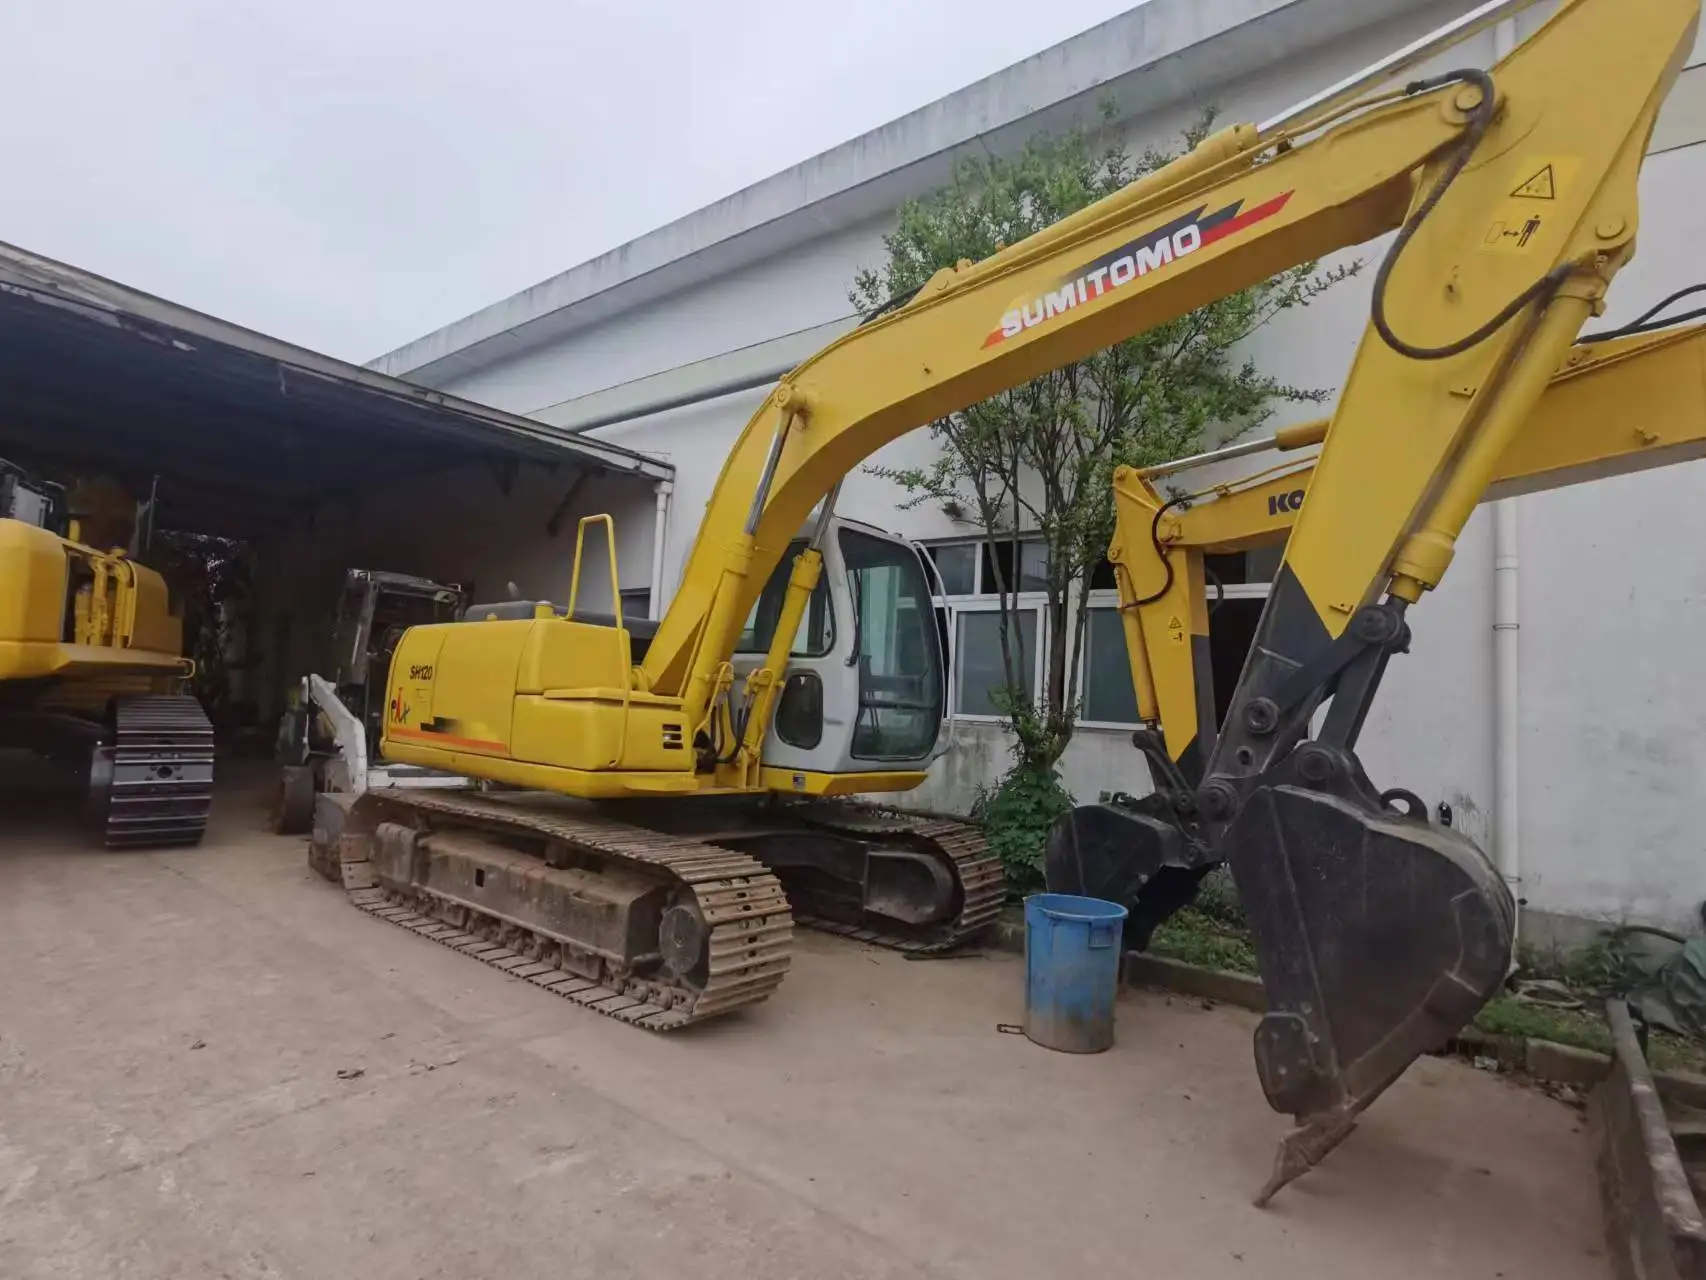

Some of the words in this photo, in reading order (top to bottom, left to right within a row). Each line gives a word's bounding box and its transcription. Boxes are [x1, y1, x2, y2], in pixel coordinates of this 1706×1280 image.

[1001, 223, 1202, 338] SUMITOMO
[1268, 489, 1306, 516] KO
[410, 665, 433, 681] SH120
